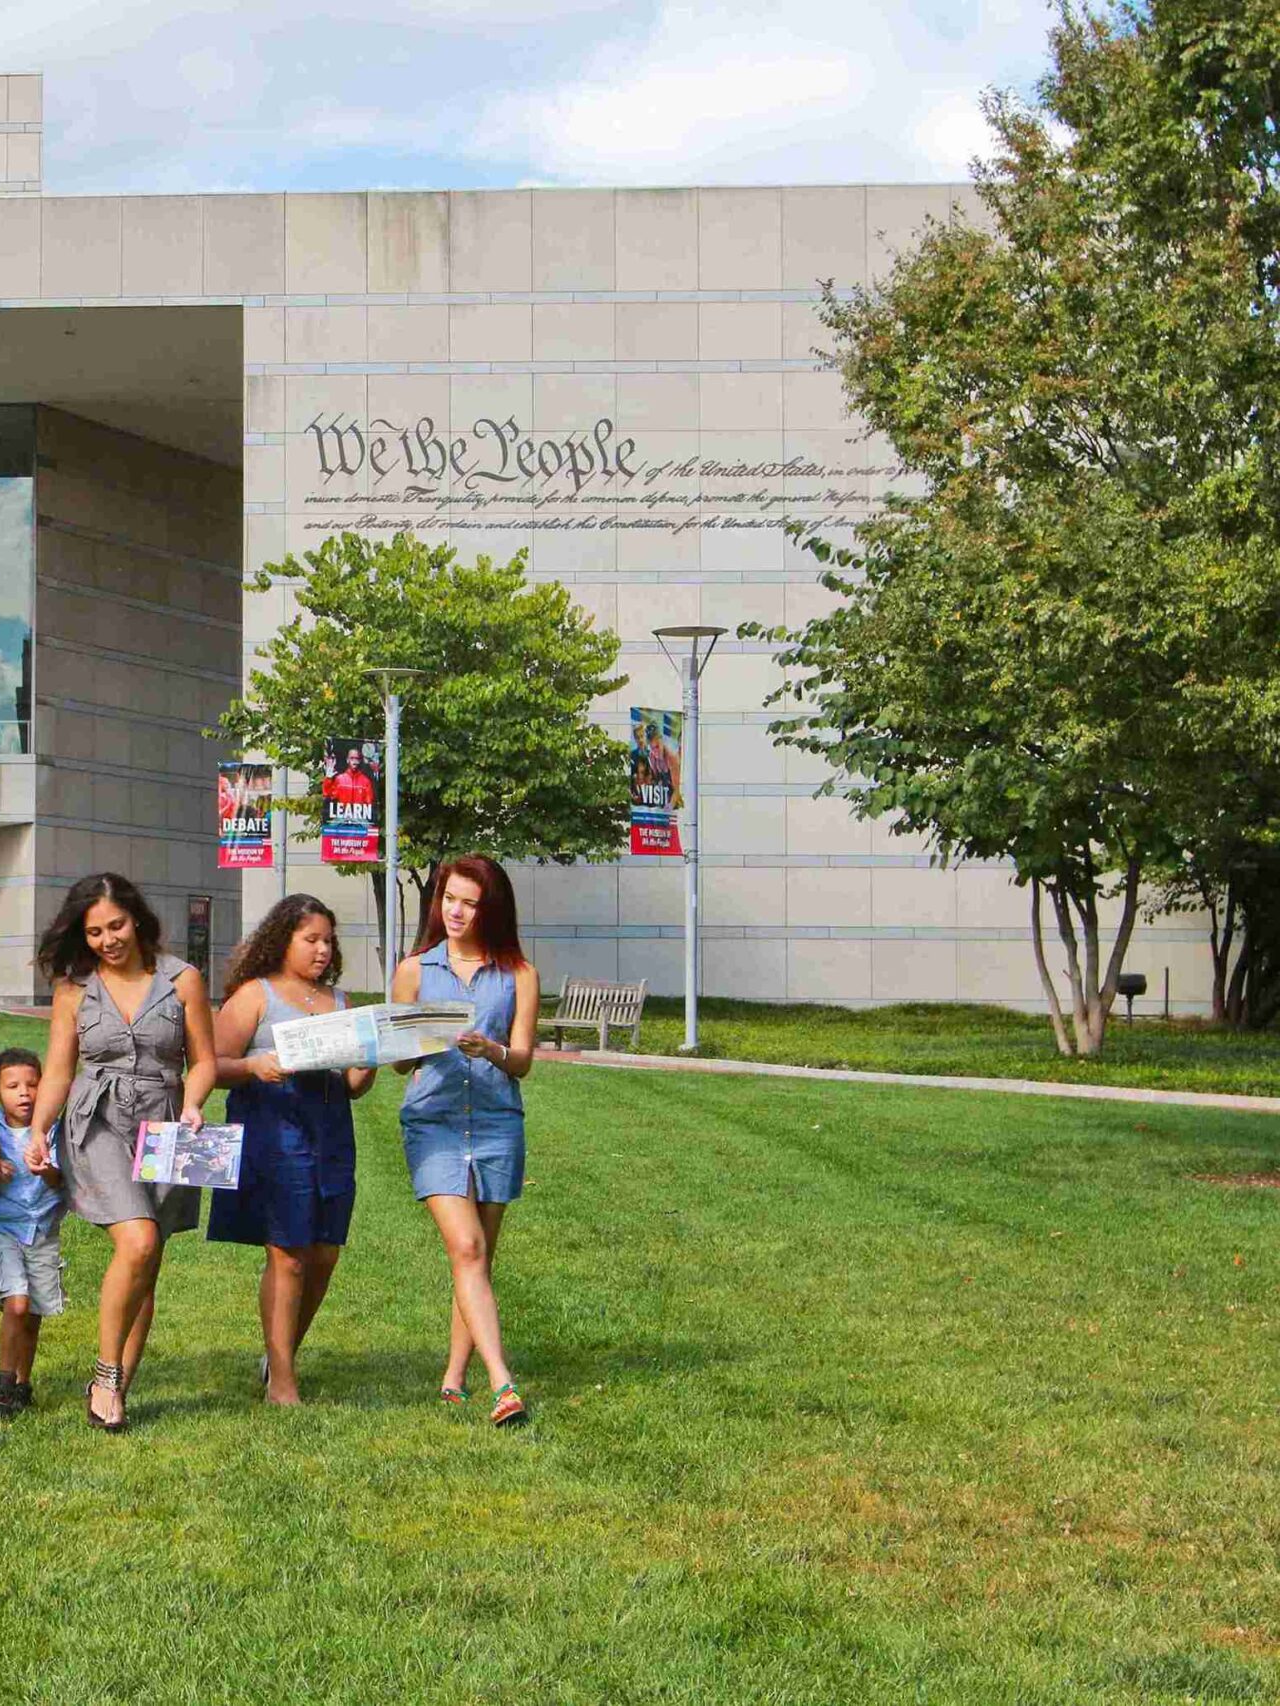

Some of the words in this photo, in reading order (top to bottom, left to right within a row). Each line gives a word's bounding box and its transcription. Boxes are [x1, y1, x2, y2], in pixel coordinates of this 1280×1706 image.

[304, 412, 401, 486] We
[399, 417, 481, 486] the
[465, 415, 648, 492] People
[643, 460, 674, 486] of
[669, 456, 700, 478] the
[700, 460, 764, 478] United
[304, 519, 333, 530] and
[640, 784, 670, 806] VISIT
[329, 802, 372, 820] LEARN
[222, 817, 269, 832] DEBATE
